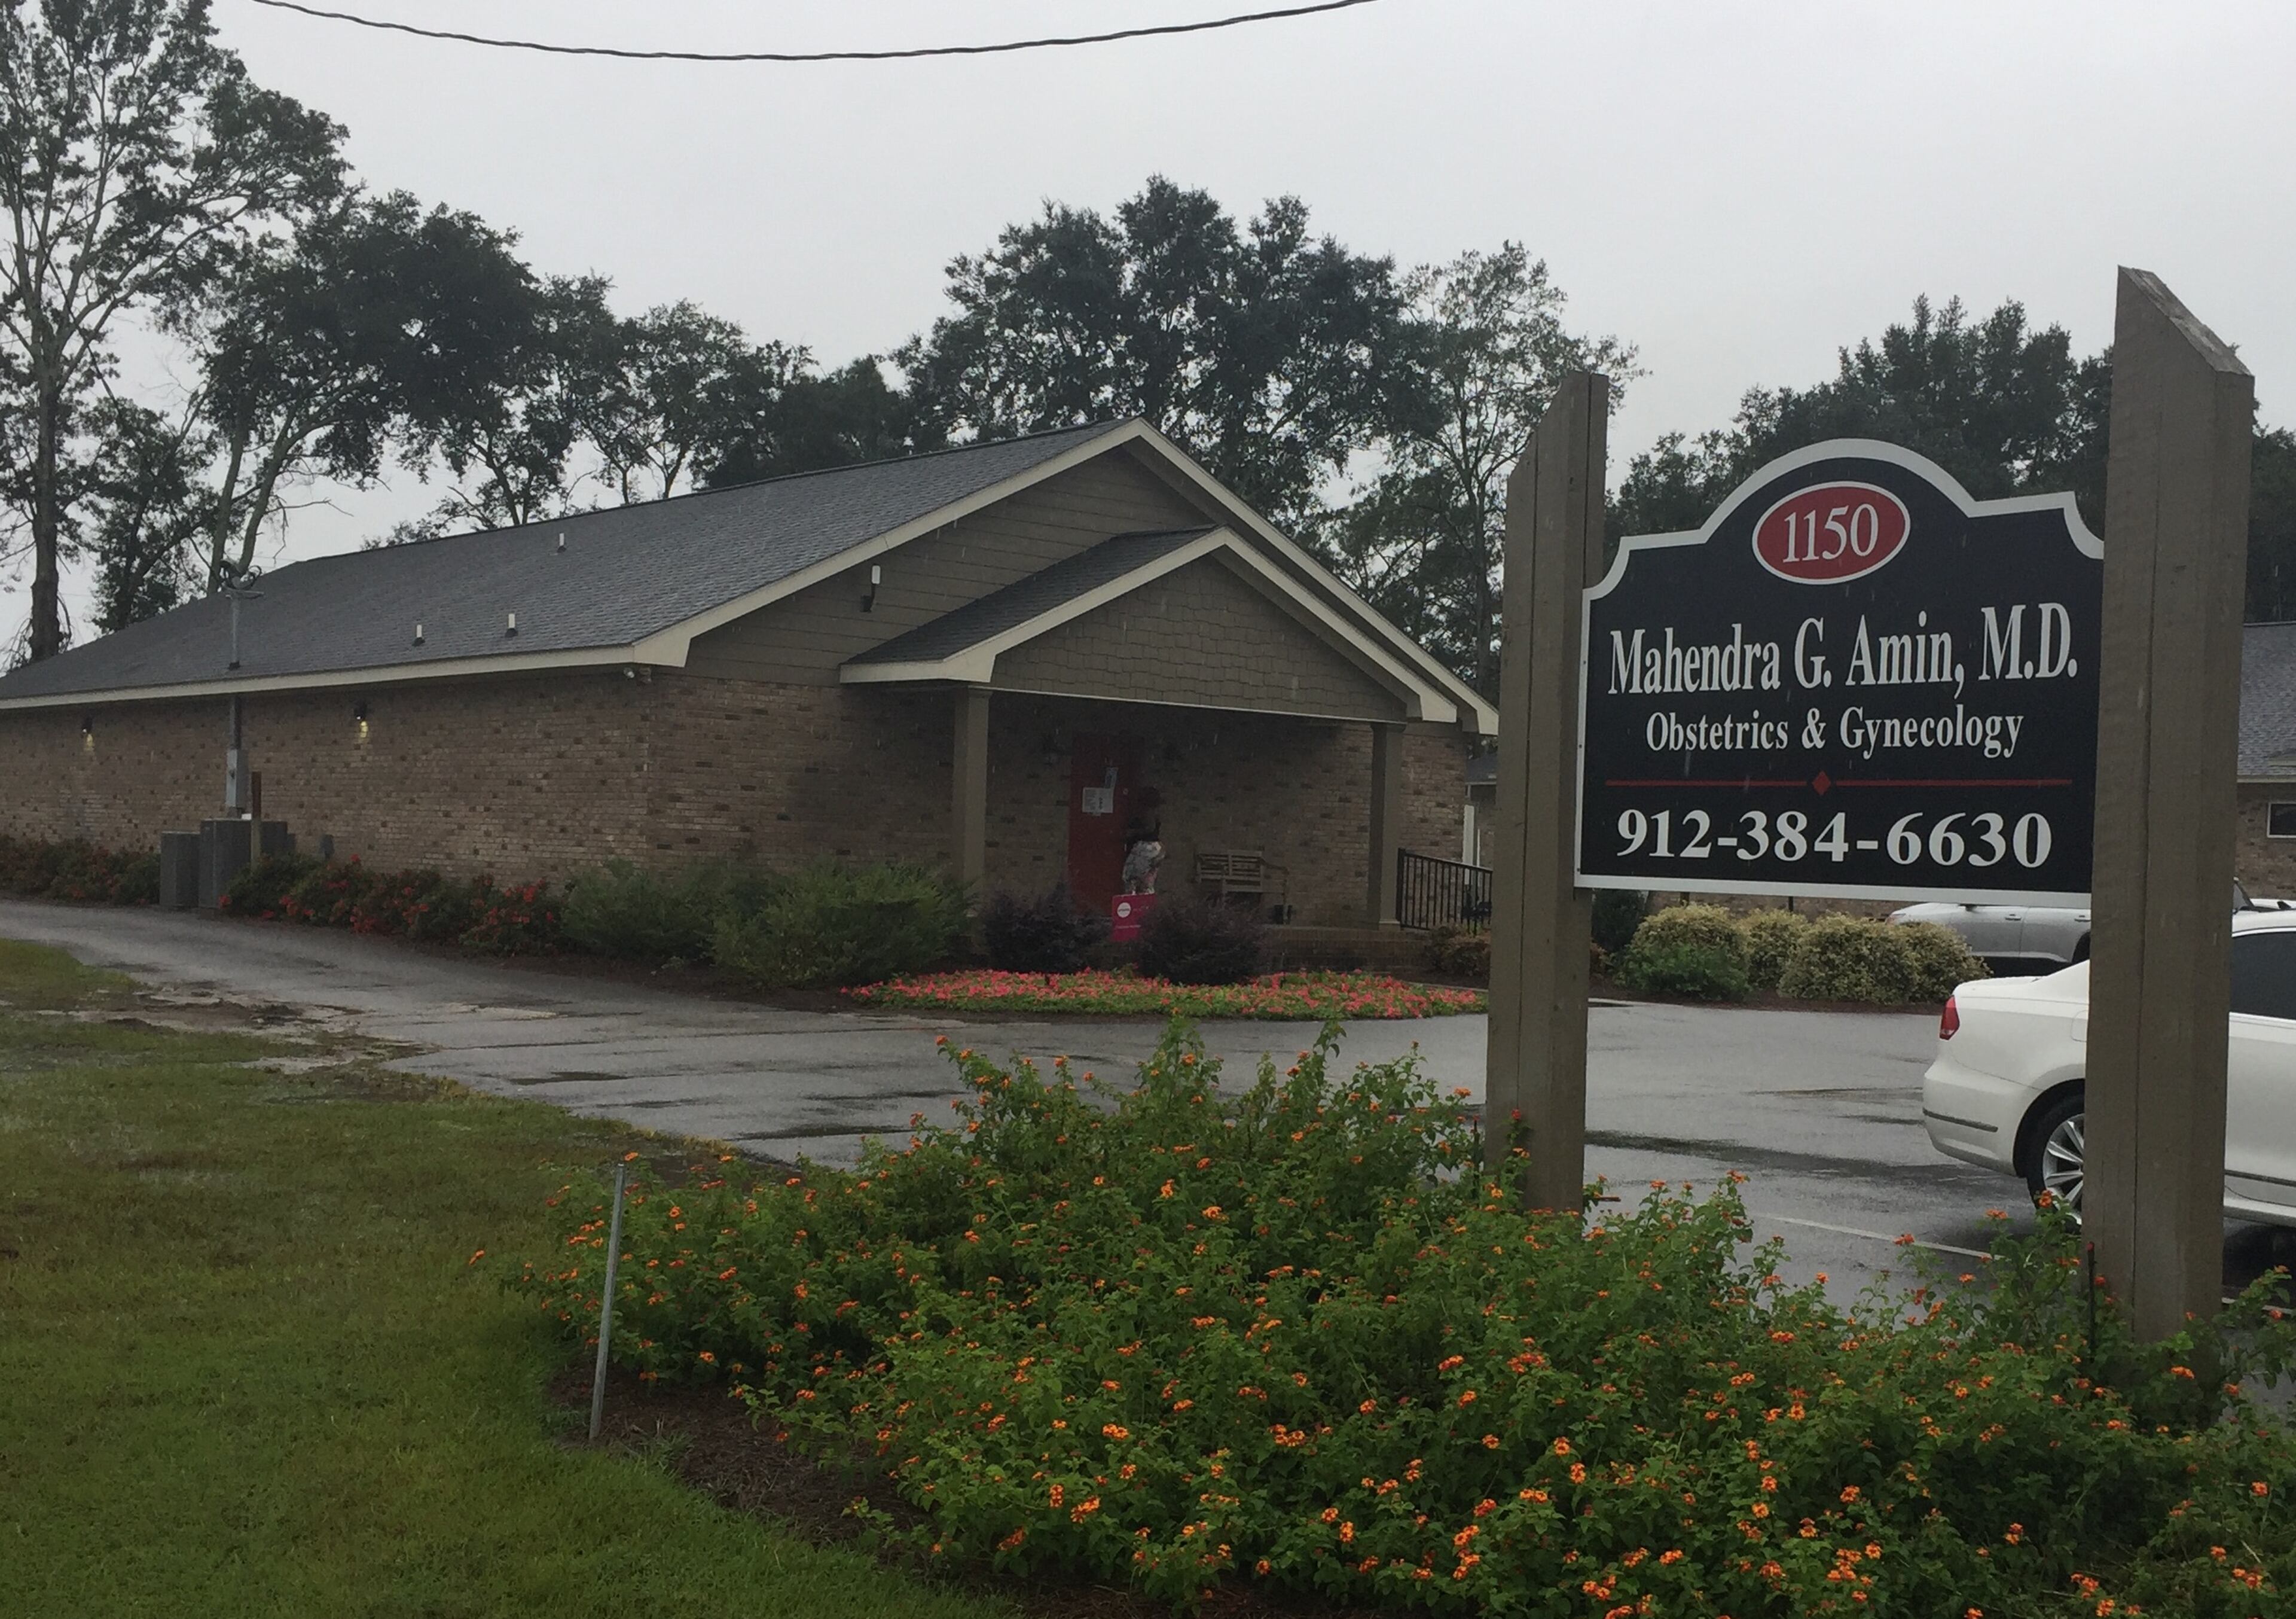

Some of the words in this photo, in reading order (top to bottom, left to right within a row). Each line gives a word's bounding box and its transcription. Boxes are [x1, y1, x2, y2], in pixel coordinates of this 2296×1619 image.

[1782, 503, 1879, 563] 1150
[1608, 623, 1781, 694] Mahendra
[1794, 617, 1832, 688] G.
[1845, 611, 1965, 699] Amin,
[1978, 602, 2077, 680] M.D.
[1647, 710, 1788, 751] Obstetrics
[1802, 708, 1827, 749] &
[1840, 704, 2025, 760] Gynecology
[1617, 809, 2051, 868] 912-384-6630
